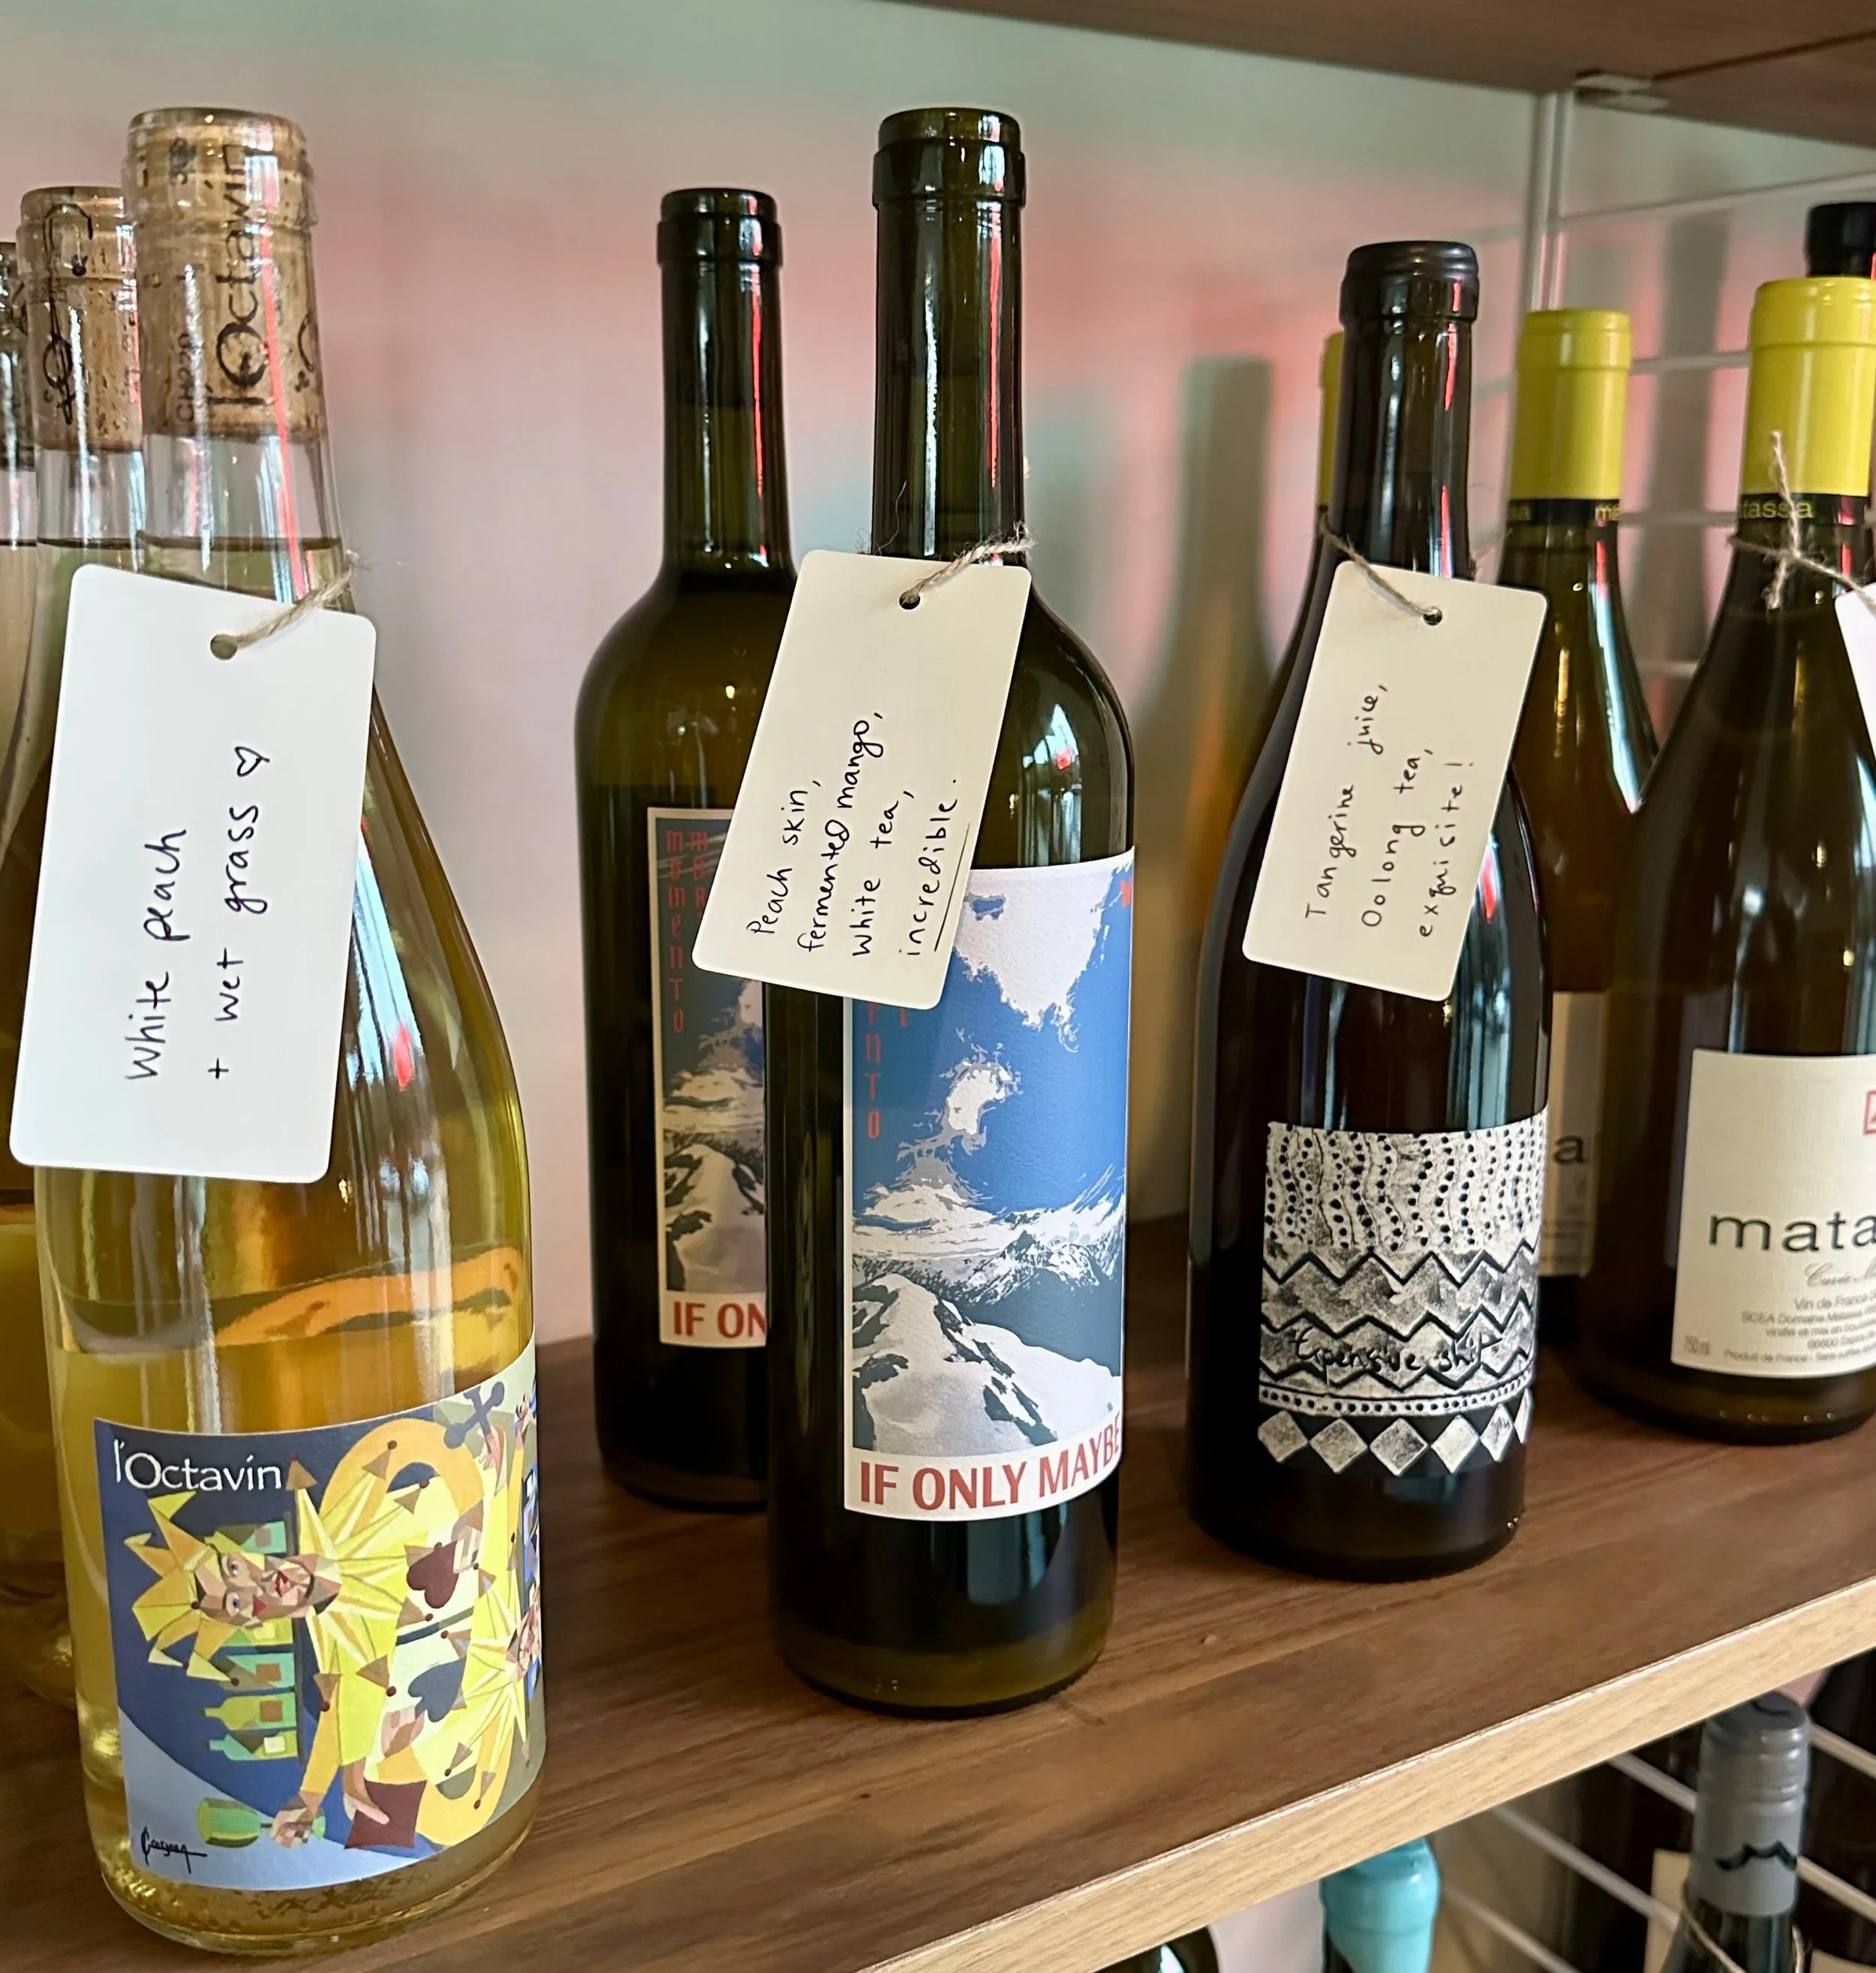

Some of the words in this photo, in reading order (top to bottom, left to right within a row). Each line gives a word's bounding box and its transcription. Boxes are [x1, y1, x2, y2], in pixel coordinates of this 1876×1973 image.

[1738, 498, 1814, 519] tassa
[869, 790, 915, 850] tea,
[1304, 784, 1357, 919] Tangerine
[1347, 684, 1388, 756] juice,
[1393, 749, 1434, 795] tea,
[224, 805, 269, 915] grass
[746, 868, 793, 935] Peach
[783, 780, 822, 846] skin,
[797, 820, 850, 952] fermented
[836, 711, 884, 809] mango,
[898, 779, 958, 957] incredible.
[1361, 824, 1427, 928] Oolong
[143, 829, 191, 943] peach
[125, 971, 171, 1080] White
[215, 947, 244, 1022] wet
[1708, 1210, 1876, 1253] mata
[673, 1300, 705, 1337] IF
[717, 1302, 765, 1338] ON
[1794, 1297, 1814, 1310] Vin
[1816, 1298, 1832, 1310] de
[860, 1461, 897, 1505] IF
[912, 1461, 1027, 1510] ONLY
[1039, 1410, 1120, 1498] MAYBE
